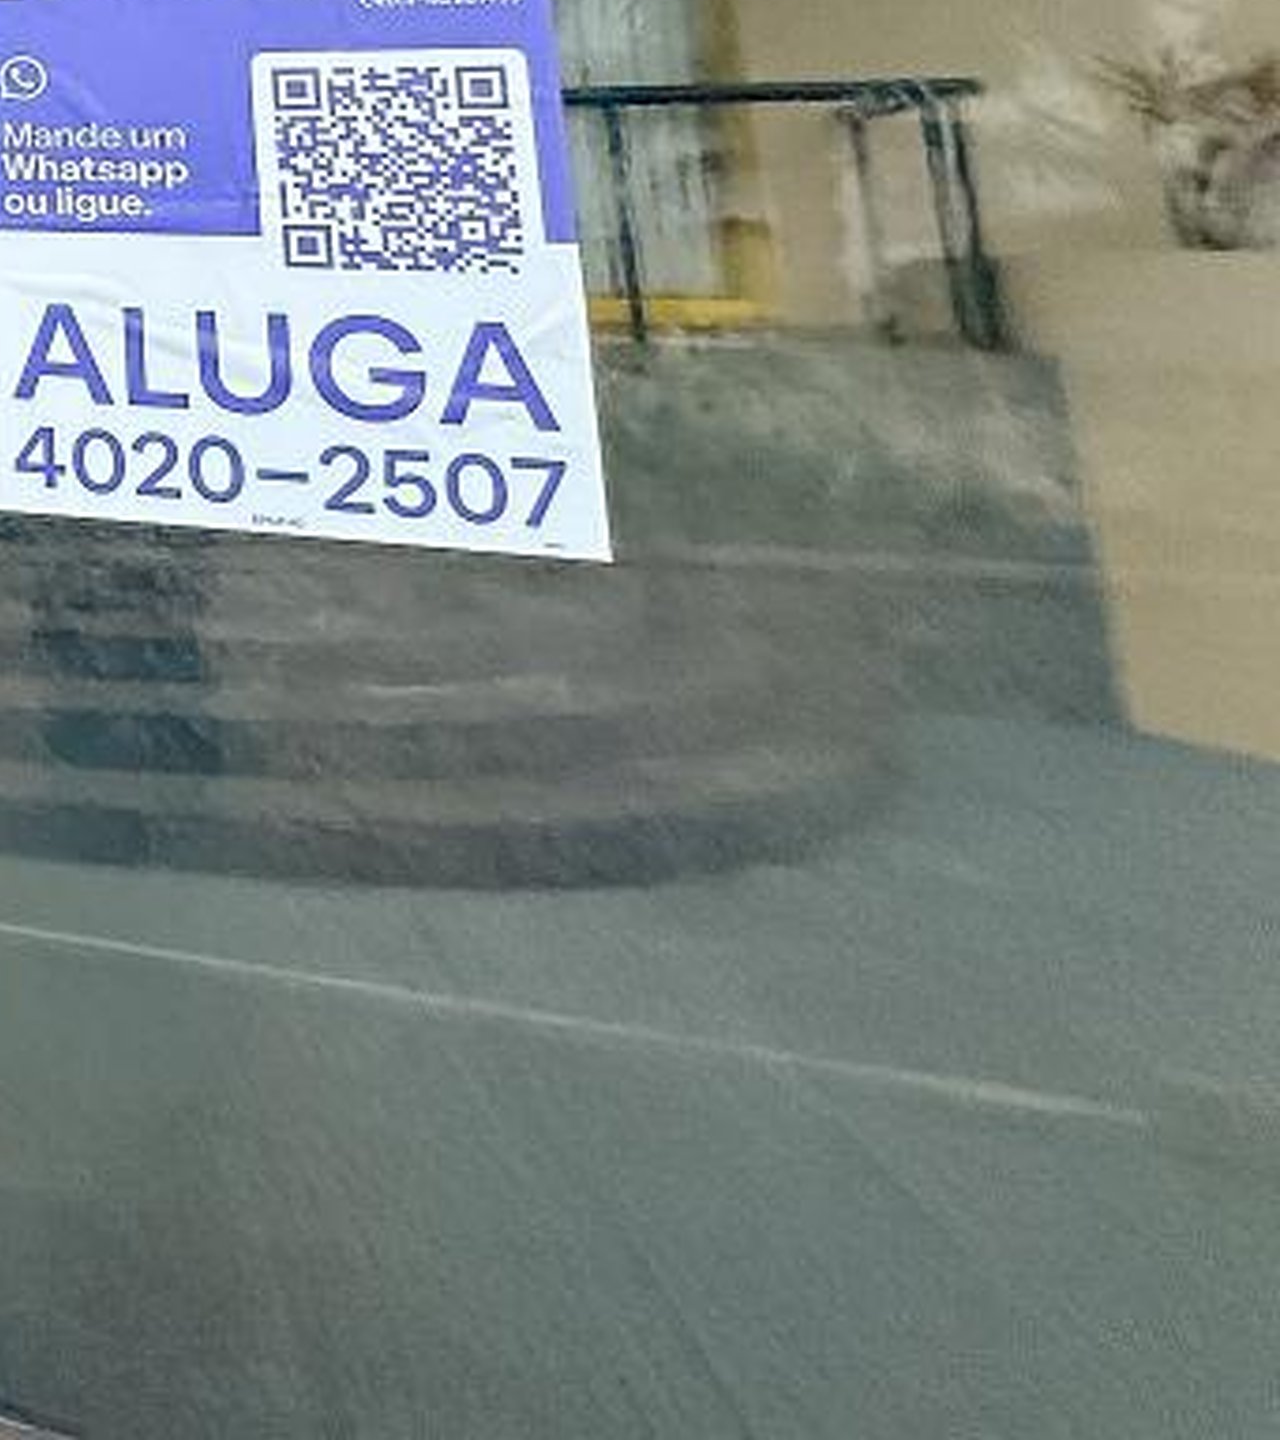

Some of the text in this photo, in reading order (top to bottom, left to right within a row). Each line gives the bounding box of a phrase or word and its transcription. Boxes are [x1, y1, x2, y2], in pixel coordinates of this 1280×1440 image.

[3, 122, 187, 149] Mande um
[1, 152, 189, 189] Whatsapp
[3, 187, 153, 222] ou ligue.
[14, 303, 562, 432] ALUGA
